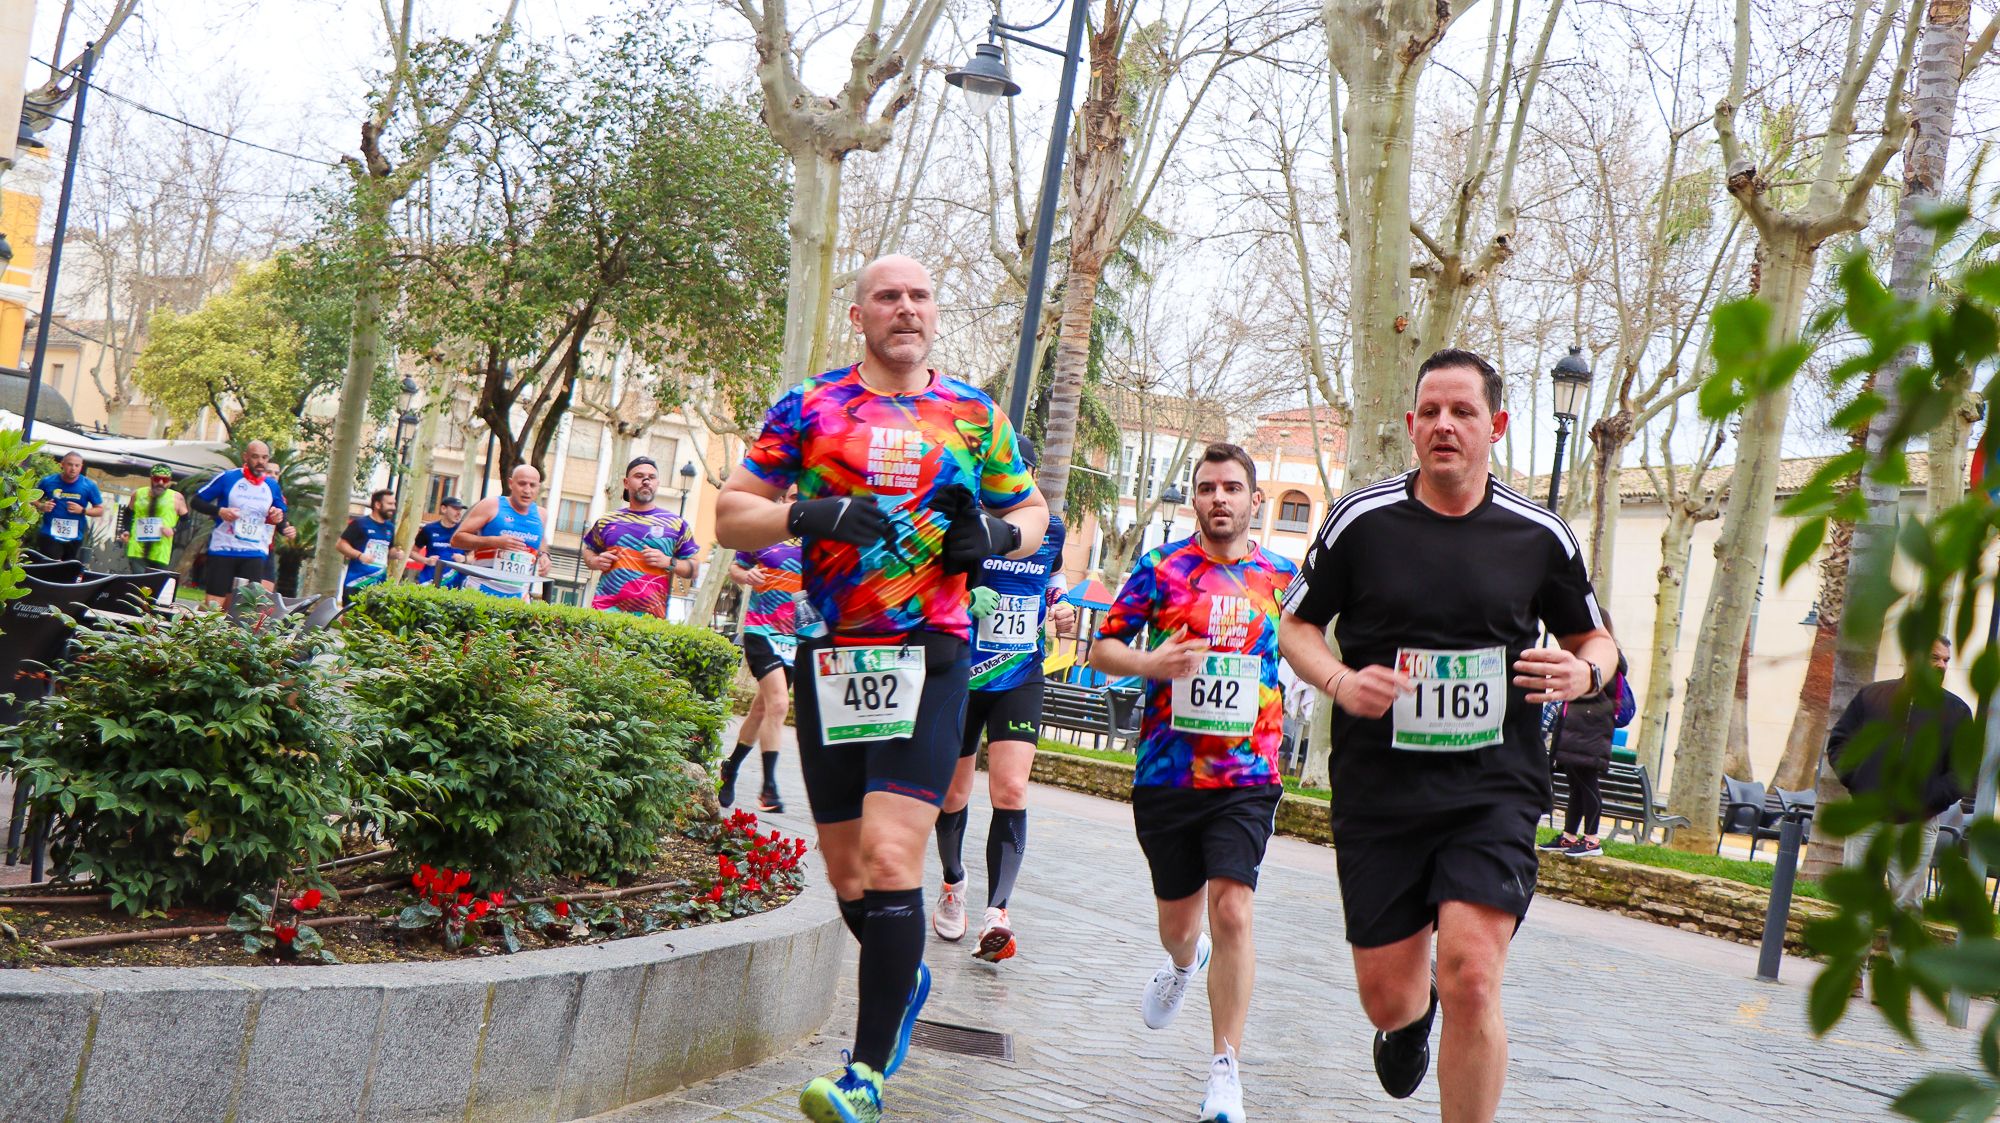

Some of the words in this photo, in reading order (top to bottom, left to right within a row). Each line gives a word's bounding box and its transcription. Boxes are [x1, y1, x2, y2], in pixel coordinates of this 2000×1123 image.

[869, 427, 903, 450] XII
[867, 460, 921, 476] MARATÓN
[143, 524, 154, 535] 83
[983, 558, 1046, 575] enerplus
[1210, 595, 1237, 616] XII
[993, 613, 1026, 635] 215
[1209, 612, 1236, 626] MEDIA
[1207, 624, 1249, 638] MARATÓN
[844, 674, 898, 711] 482
[1190, 677, 1240, 710] 642
[1414, 683, 1489, 720] 1163
